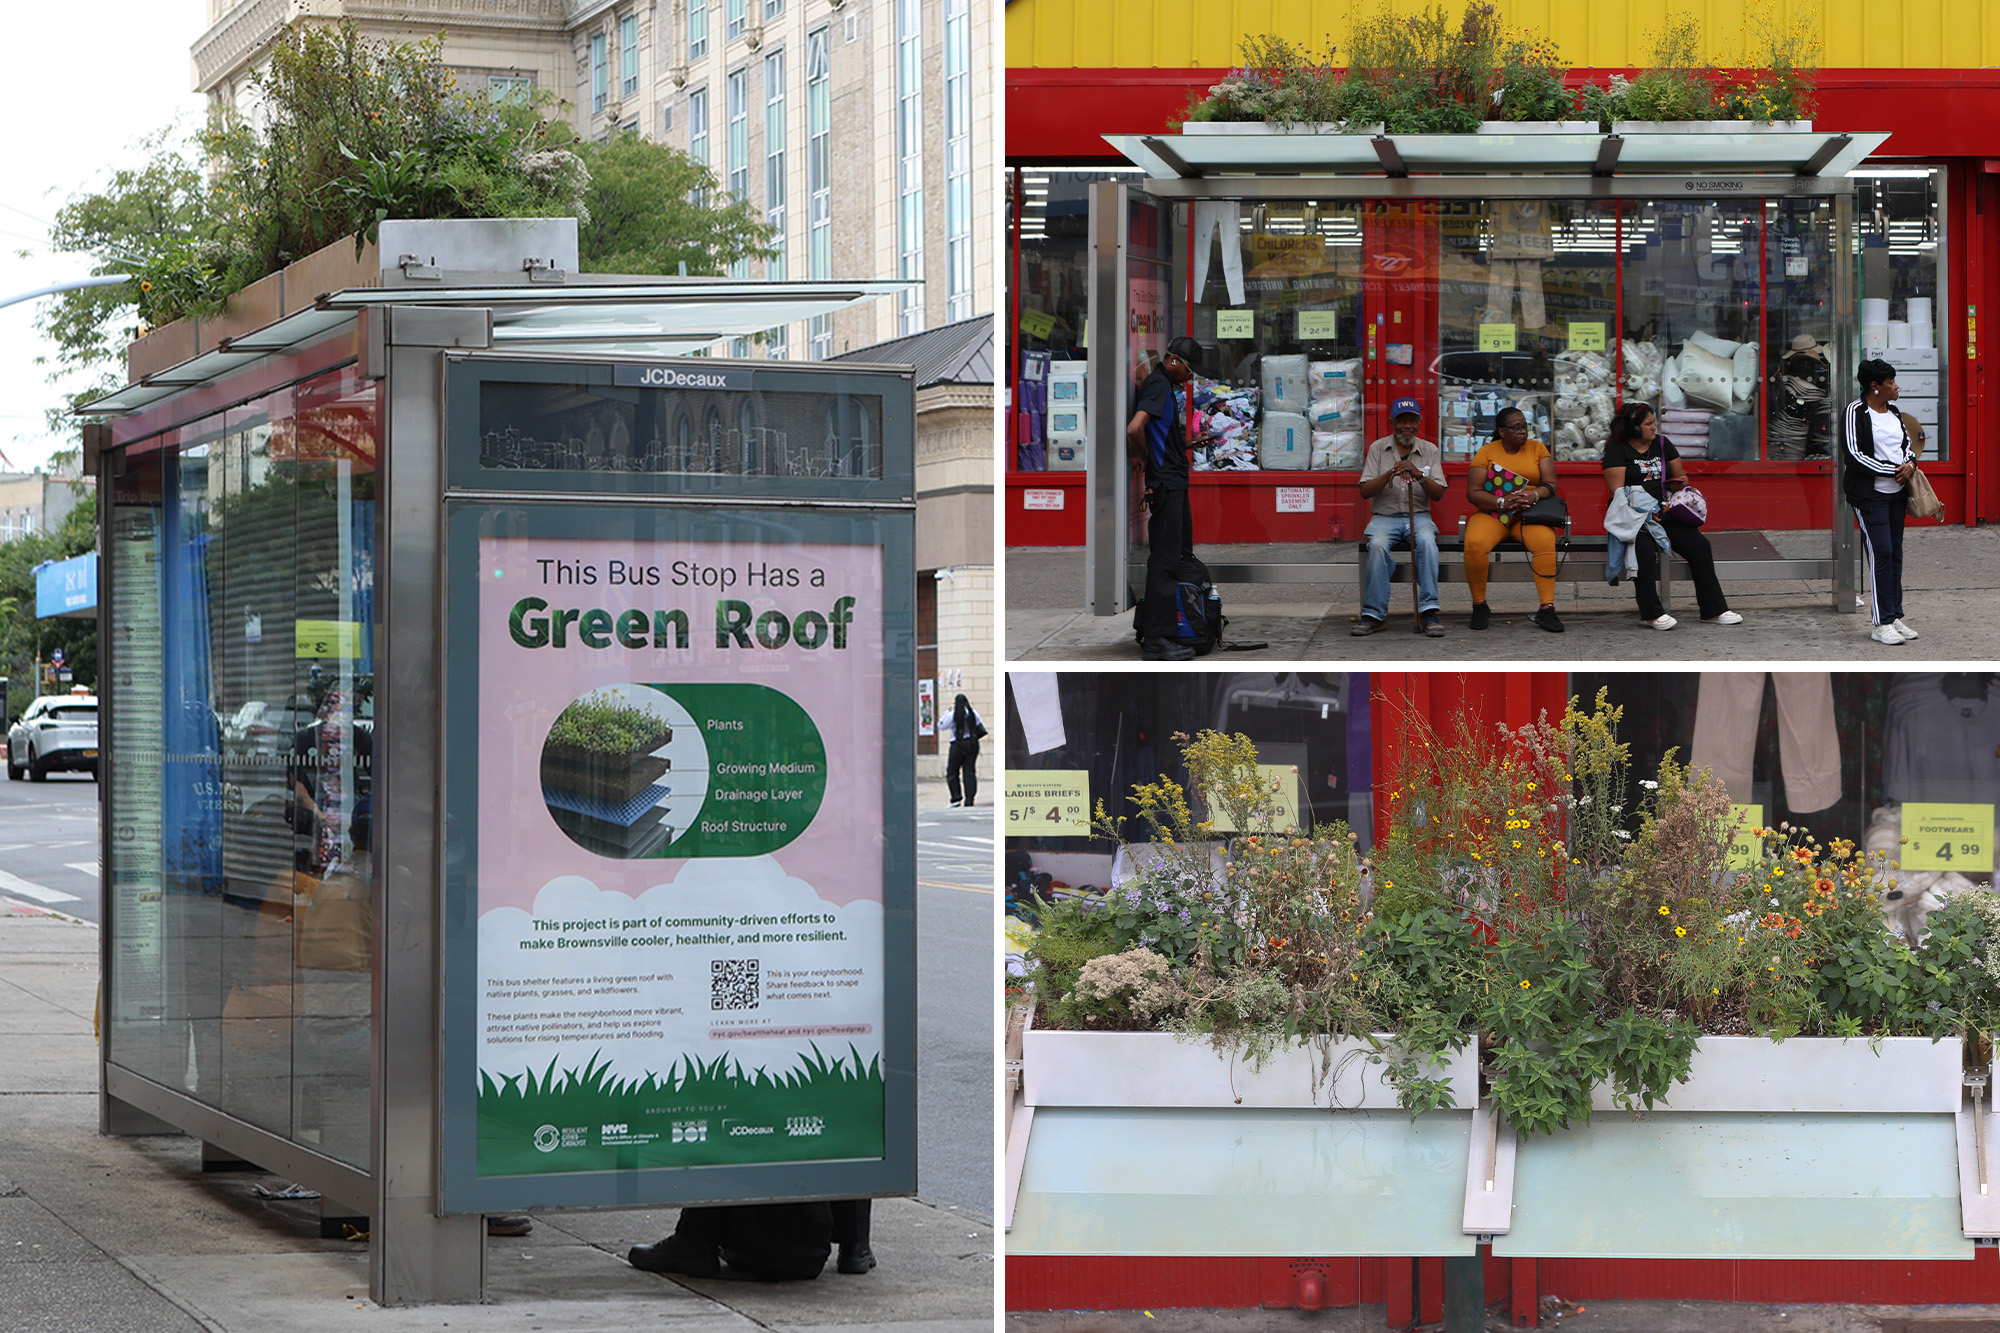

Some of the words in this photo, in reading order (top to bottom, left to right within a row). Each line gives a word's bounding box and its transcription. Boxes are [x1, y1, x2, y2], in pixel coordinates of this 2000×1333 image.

[1131, 308, 1150, 334] Green
[1493, 340, 1500, 348] 9
[1582, 338, 1589, 346] 4
[640, 368, 726, 387] JCDecaux
[536, 559, 597, 585] This
[608, 560, 660, 586] Bus
[671, 561, 737, 592] Stop
[748, 562, 800, 587] Has
[810, 568, 825, 587] a
[508, 596, 690, 650] Green
[715, 596, 856, 650] Roof
[707, 719, 744, 730] Plants
[716, 762, 766, 776] Growing
[769, 762, 816, 774] Medium
[715, 789, 768, 802] Drainage
[771, 789, 803, 802] Layer
[1046, 806, 1061, 823] 4
[701, 821, 729, 832] Roof
[732, 821, 787, 832] Structure
[1913, 842, 1920, 850] $
[1936, 842, 1953, 861] 4
[1961, 844, 1980, 855] 99
[532, 919, 560, 931] This
[562, 918, 606, 932] project
[610, 918, 620, 928] is
[622, 918, 646, 931] part
[650, 916, 662, 928] of
[665, 914, 778, 928] community-driven
[780, 913, 820, 925] efforts
[823, 914, 836, 924] to
[520, 938, 554, 949] make
[557, 936, 628, 948] Brownsville
[631, 935, 673, 947] cooler,
[676, 933, 734, 946] healthier,
[737, 932, 760, 943] and
[763, 933, 793, 943] more
[796, 930, 847, 942] resilient.
[810, 968, 864, 978] neighborhood.
[487, 979, 505, 987] This
[523, 978, 550, 986] shelter
[552, 976, 584, 985] features
[593, 976, 613, 986] living
[614, 977, 637, 985] green
[639, 974, 655, 982] roof
[790, 980, 825, 988] feedback
[836, 980, 859, 988] shape
[486, 990, 511, 998] native
[513, 990, 541, 999] plants,
[542, 990, 576, 998] grasses,
[594, 987, 640, 995] wildflowers.
[766, 992, 785, 1000] what
[487, 1013, 512, 1021] These
[513, 1012, 538, 1021] plants
[540, 1011, 562, 1019] make
[563, 1010, 576, 1018] the
[578, 1008, 632, 1019] neighborhood
[655, 1007, 685, 1016] vibrant,
[486, 1024, 514, 1032] attract
[541, 1023, 585, 1032] pollinators,
[587, 1021, 601, 1029] and
[603, 1021, 621, 1030] help
[633, 1019, 661, 1028] explore
[487, 1036, 523, 1044] solutions
[538, 1034, 560, 1042] rising
[561, 1032, 614, 1041] temperatures
[616, 1031, 630, 1039] and
[632, 1030, 665, 1038] flooding.
[645, 1106, 682, 1114] BROUGHT
[601, 1124, 628, 1134] NYC
[672, 1126, 707, 1143] DOT
[730, 1126, 774, 1136] JCDecaux
